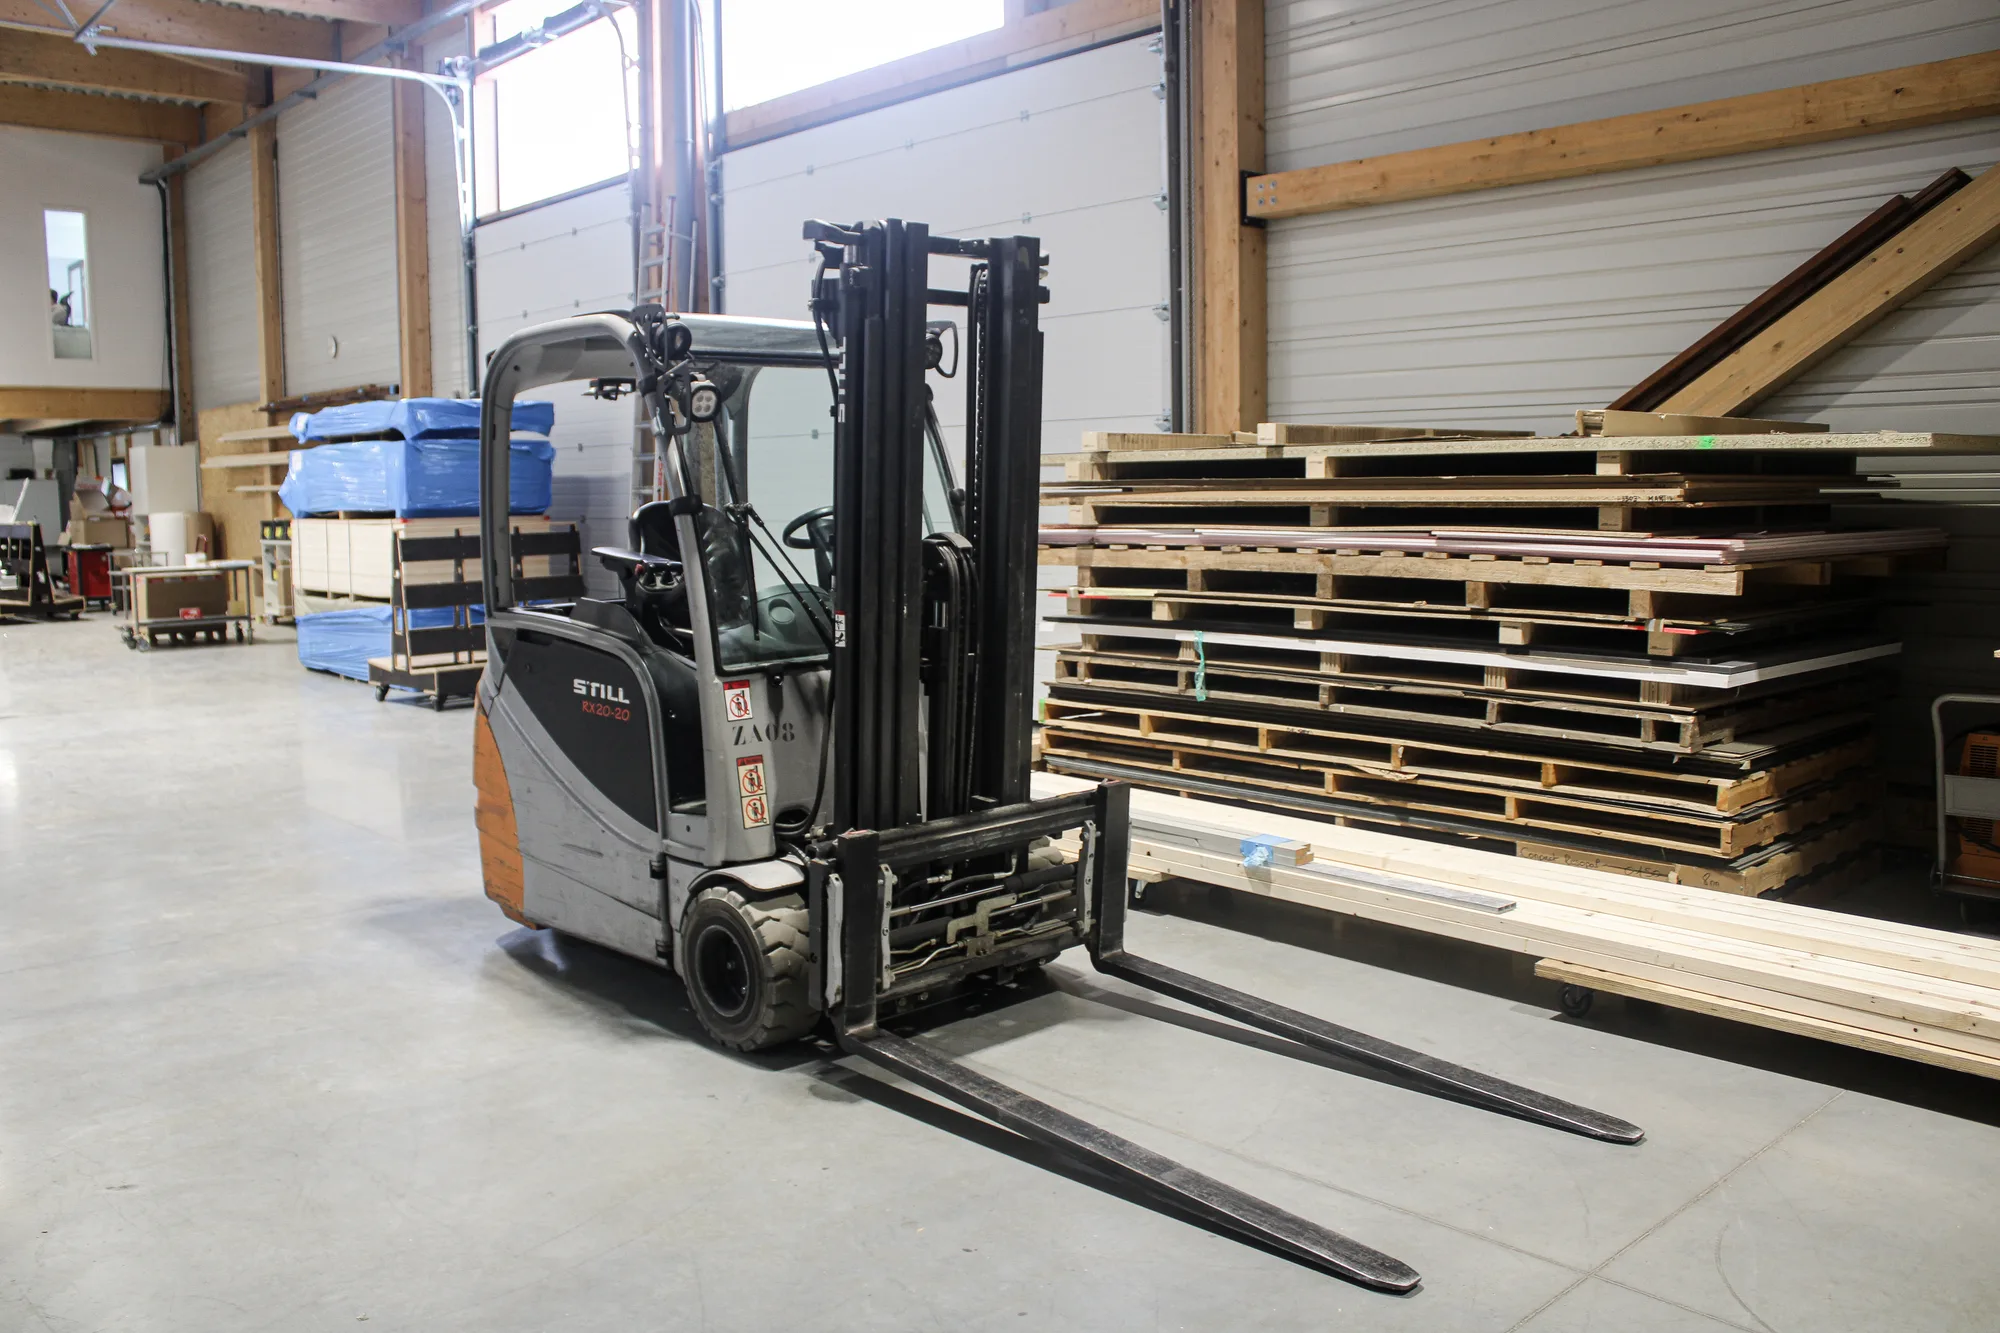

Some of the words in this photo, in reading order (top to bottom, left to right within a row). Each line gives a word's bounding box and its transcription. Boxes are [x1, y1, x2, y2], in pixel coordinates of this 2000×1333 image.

[573, 678, 631, 704] STILL
[582, 700, 631, 721] RX20-20
[732, 722, 795, 746] ZA08
